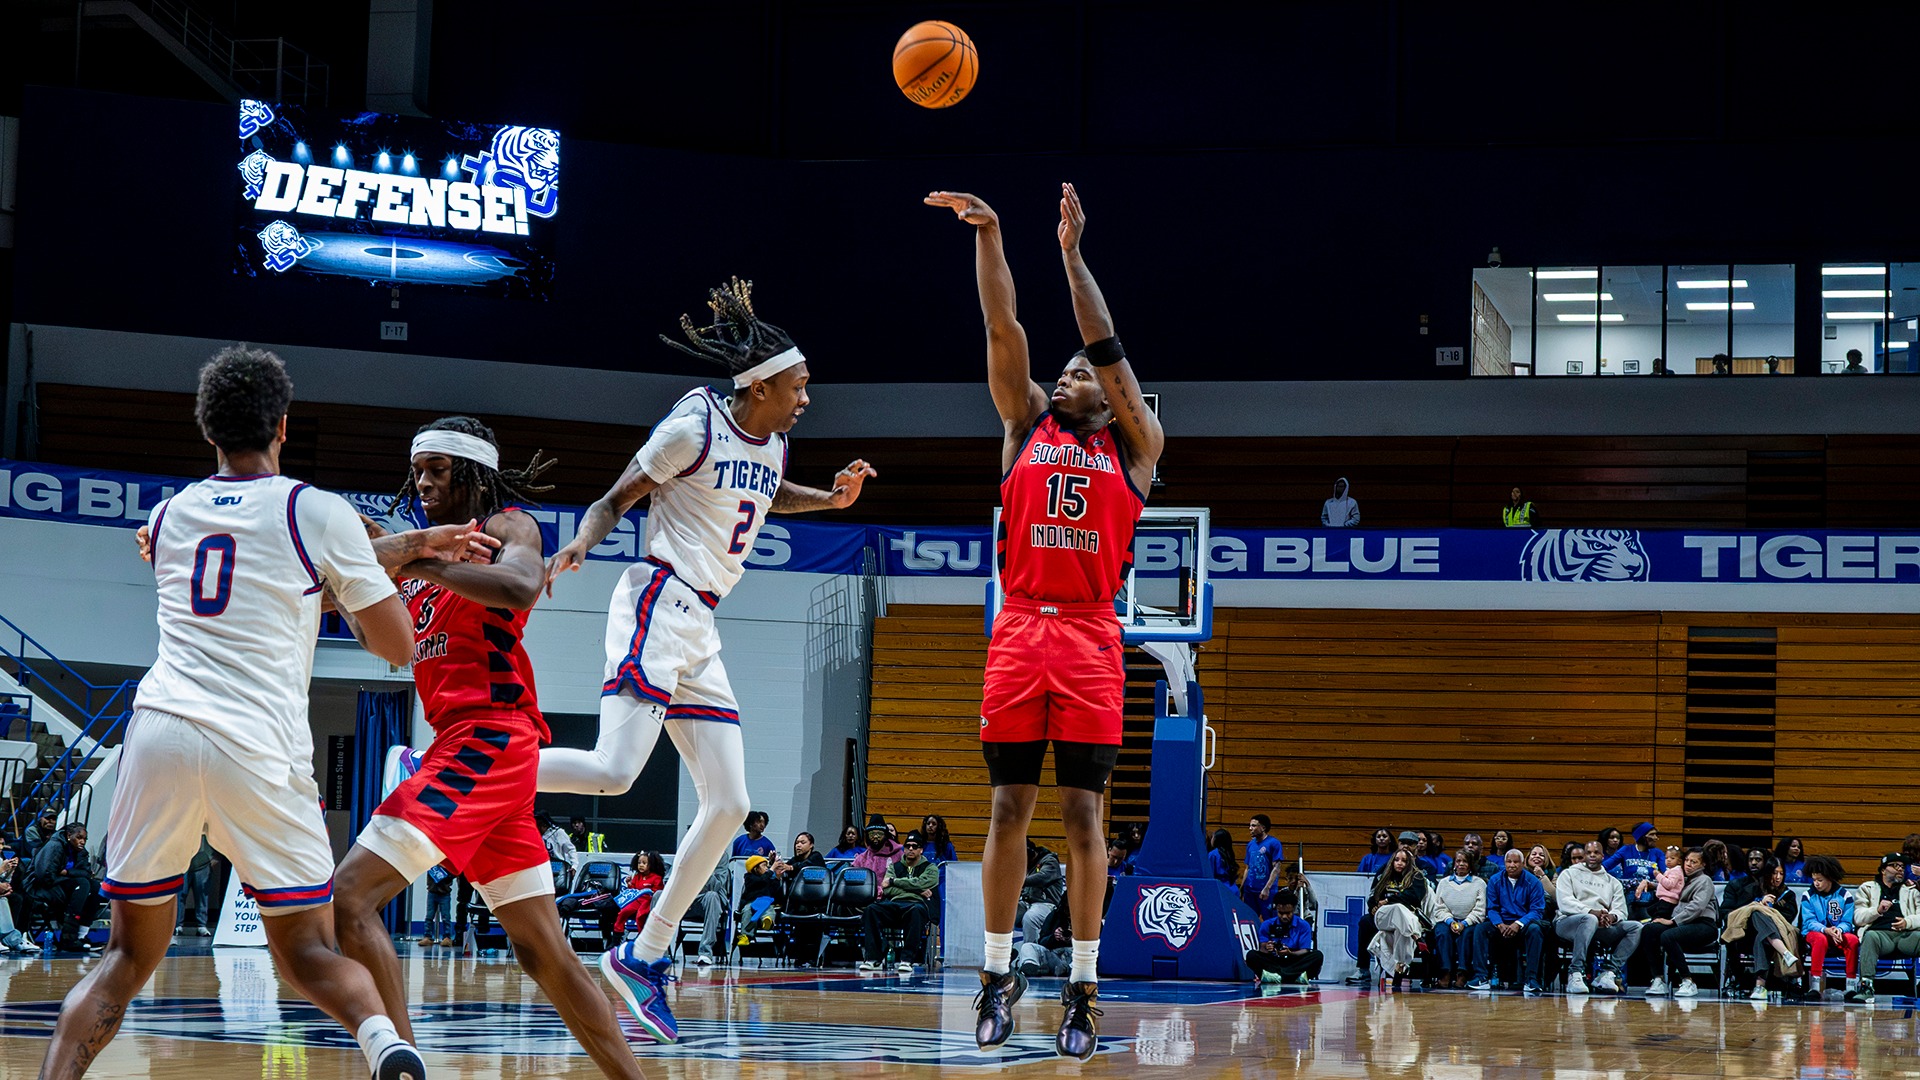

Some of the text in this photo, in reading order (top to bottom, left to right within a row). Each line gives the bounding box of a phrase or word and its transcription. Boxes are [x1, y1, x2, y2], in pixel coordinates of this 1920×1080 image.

[254, 160, 529, 235] DEFENSE!
[385, 325, 404, 336] T-17
[1440, 350, 1459, 361] T-18
[1029, 443, 1116, 474] SOUTHERN
[713, 460, 778, 498] TIGERS
[1047, 472, 1091, 521] 15
[728, 500, 756, 554] 2
[1031, 524, 1099, 554] INDIANA
[1134, 536, 1440, 573] BIG BLUE
[191, 533, 236, 617] 0
[235, 900, 259, 909] WAT
[234, 924, 257, 933] STEP
